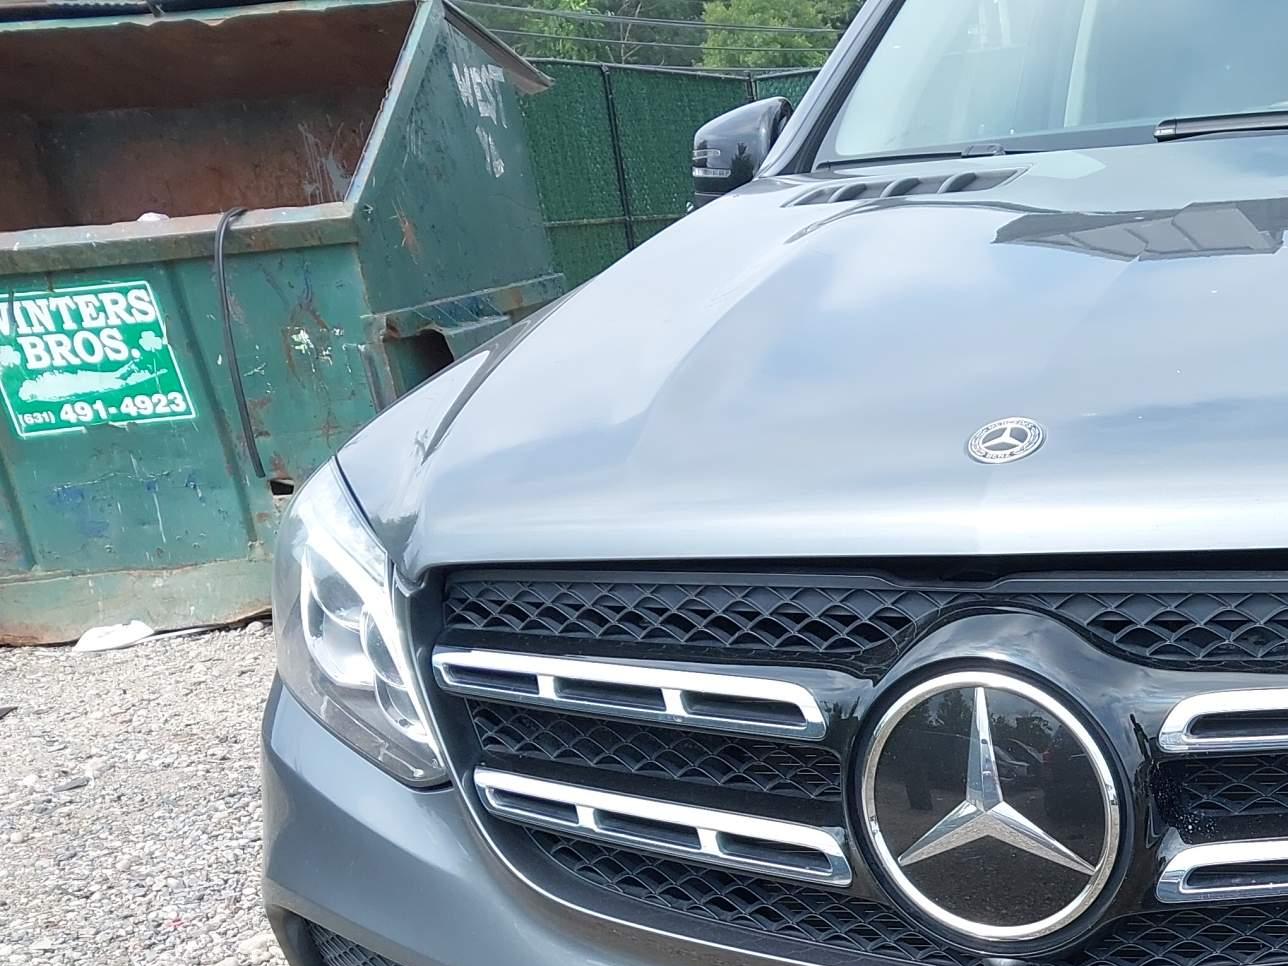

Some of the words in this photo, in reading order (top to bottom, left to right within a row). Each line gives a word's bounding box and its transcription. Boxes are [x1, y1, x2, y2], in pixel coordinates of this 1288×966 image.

[16, 327, 141, 370] BROS.
[18, 410, 56, 424] (631)
[59, 391, 187, 423] 491-4923
